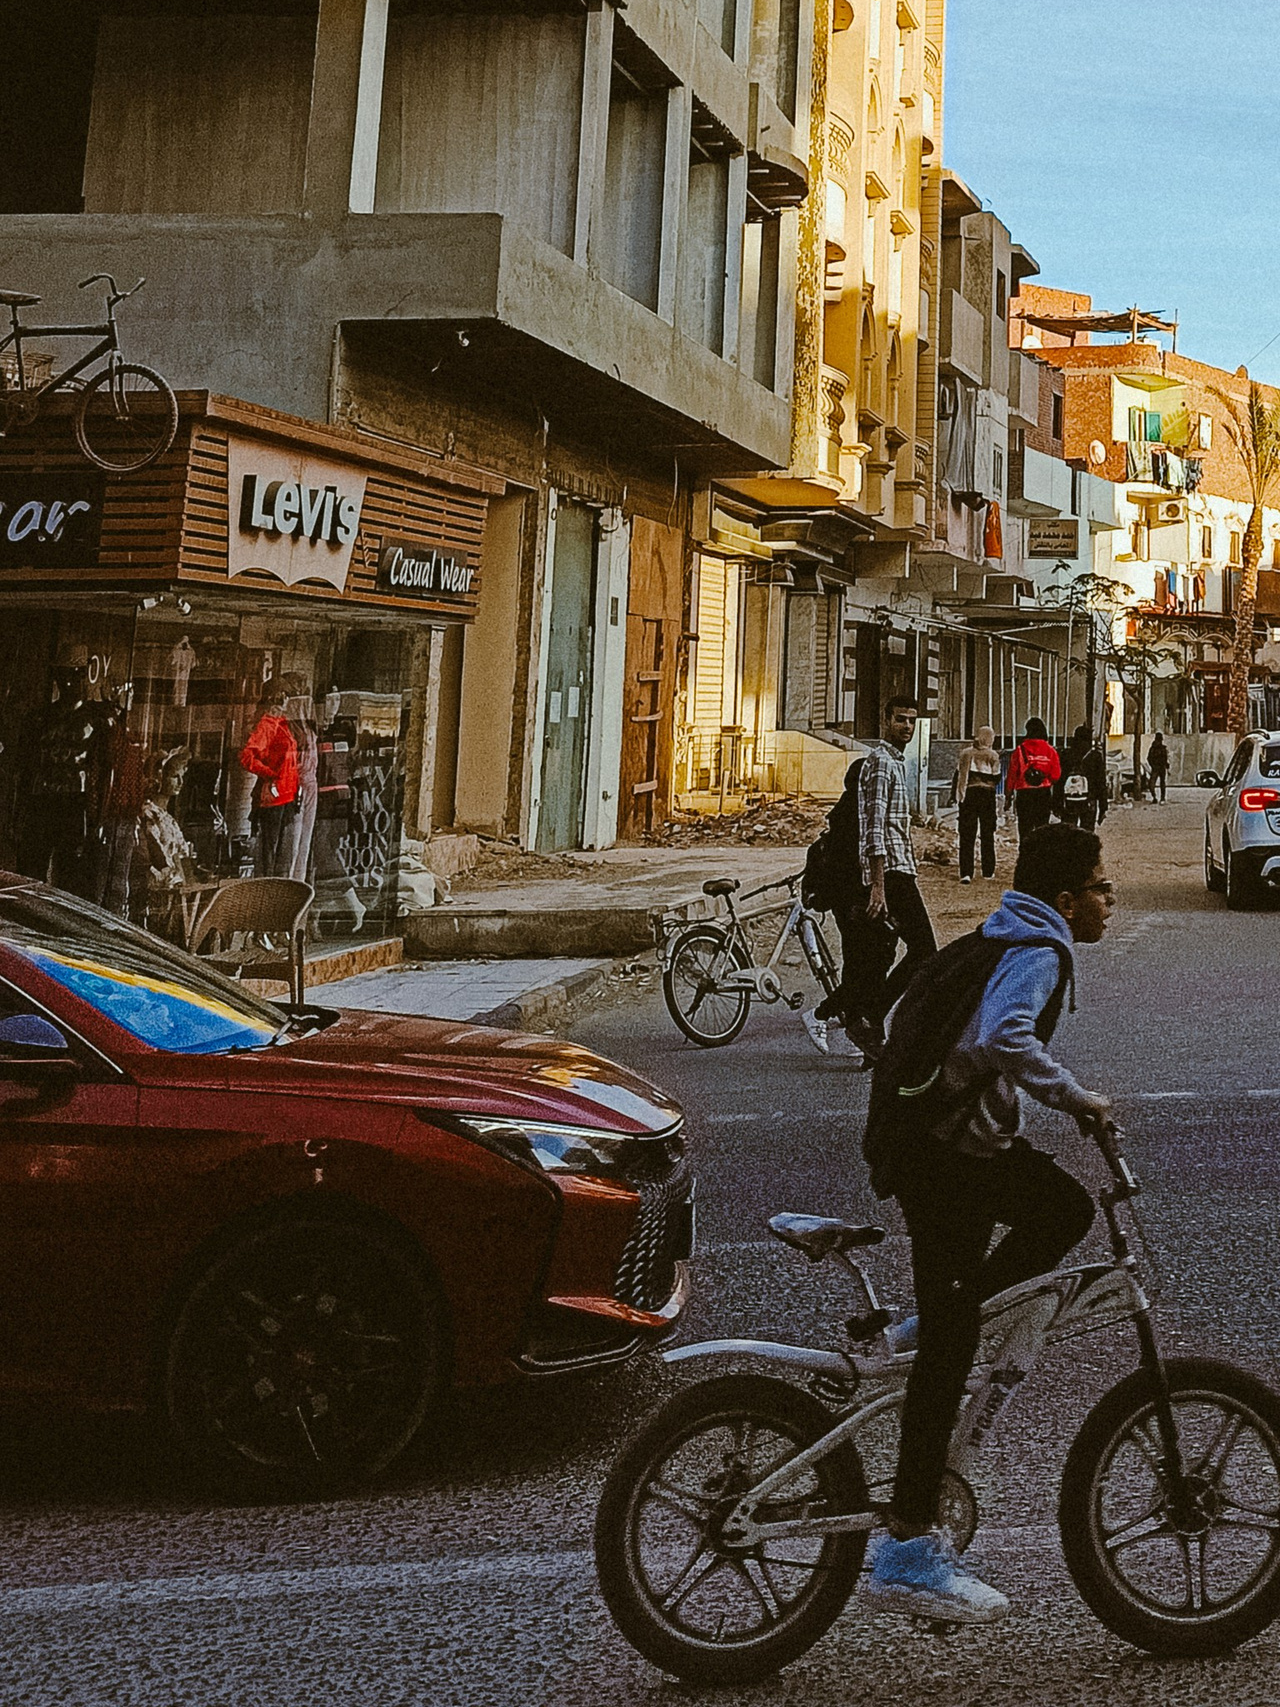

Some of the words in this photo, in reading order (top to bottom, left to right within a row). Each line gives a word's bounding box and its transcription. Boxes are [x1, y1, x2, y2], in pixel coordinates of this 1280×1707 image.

[0, 500, 91, 542] ar
[250, 474, 358, 545] Levi's
[390, 546, 437, 588] Casual
[440, 556, 475, 593] Wear
